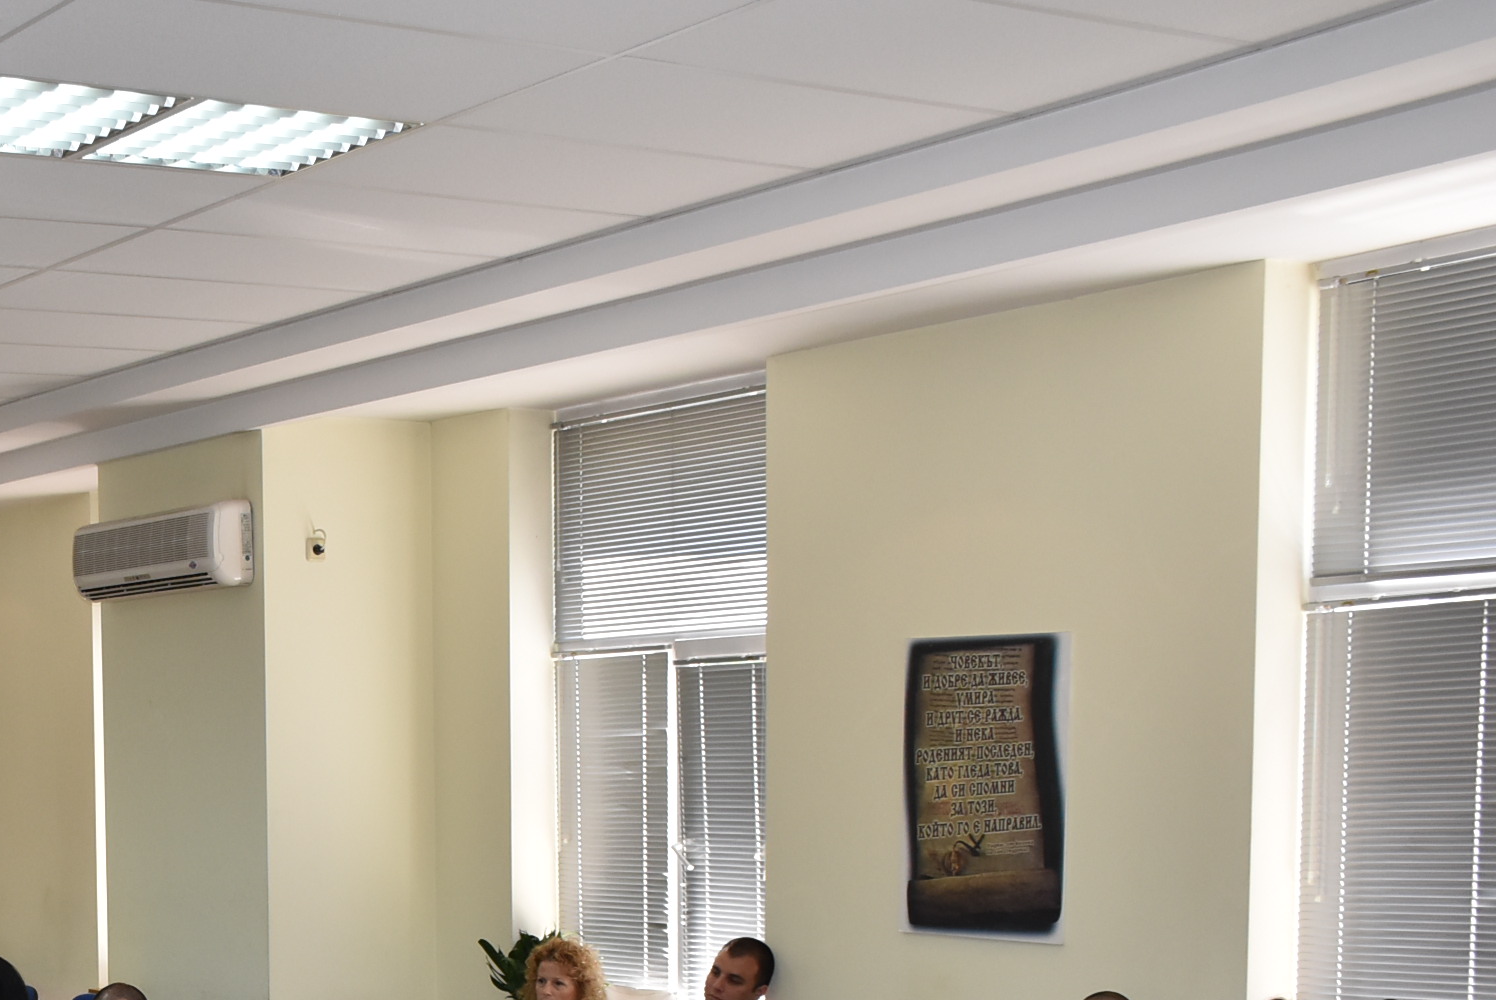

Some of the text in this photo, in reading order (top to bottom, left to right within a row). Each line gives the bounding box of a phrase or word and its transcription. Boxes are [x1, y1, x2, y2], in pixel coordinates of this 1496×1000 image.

[922, 671, 1029, 690] И ДОБРЕ ДА ЖИВЕЕ,
[956, 690, 995, 707] УМИРА
[926, 711, 934, 726] И
[967, 709, 982, 723] СЕ
[955, 726, 994, 742] И НЕКА
[916, 746, 973, 764] РОДЕНИЯТ
[926, 766, 954, 781] КАТО
[957, 763, 990, 779] ГЛЕДА
[934, 780, 1015, 800] ДА СИ СПОМНИ
[950, 802, 964, 816] ЗА
[917, 821, 954, 839] КОЙТО
[957, 821, 970, 836] ГО
